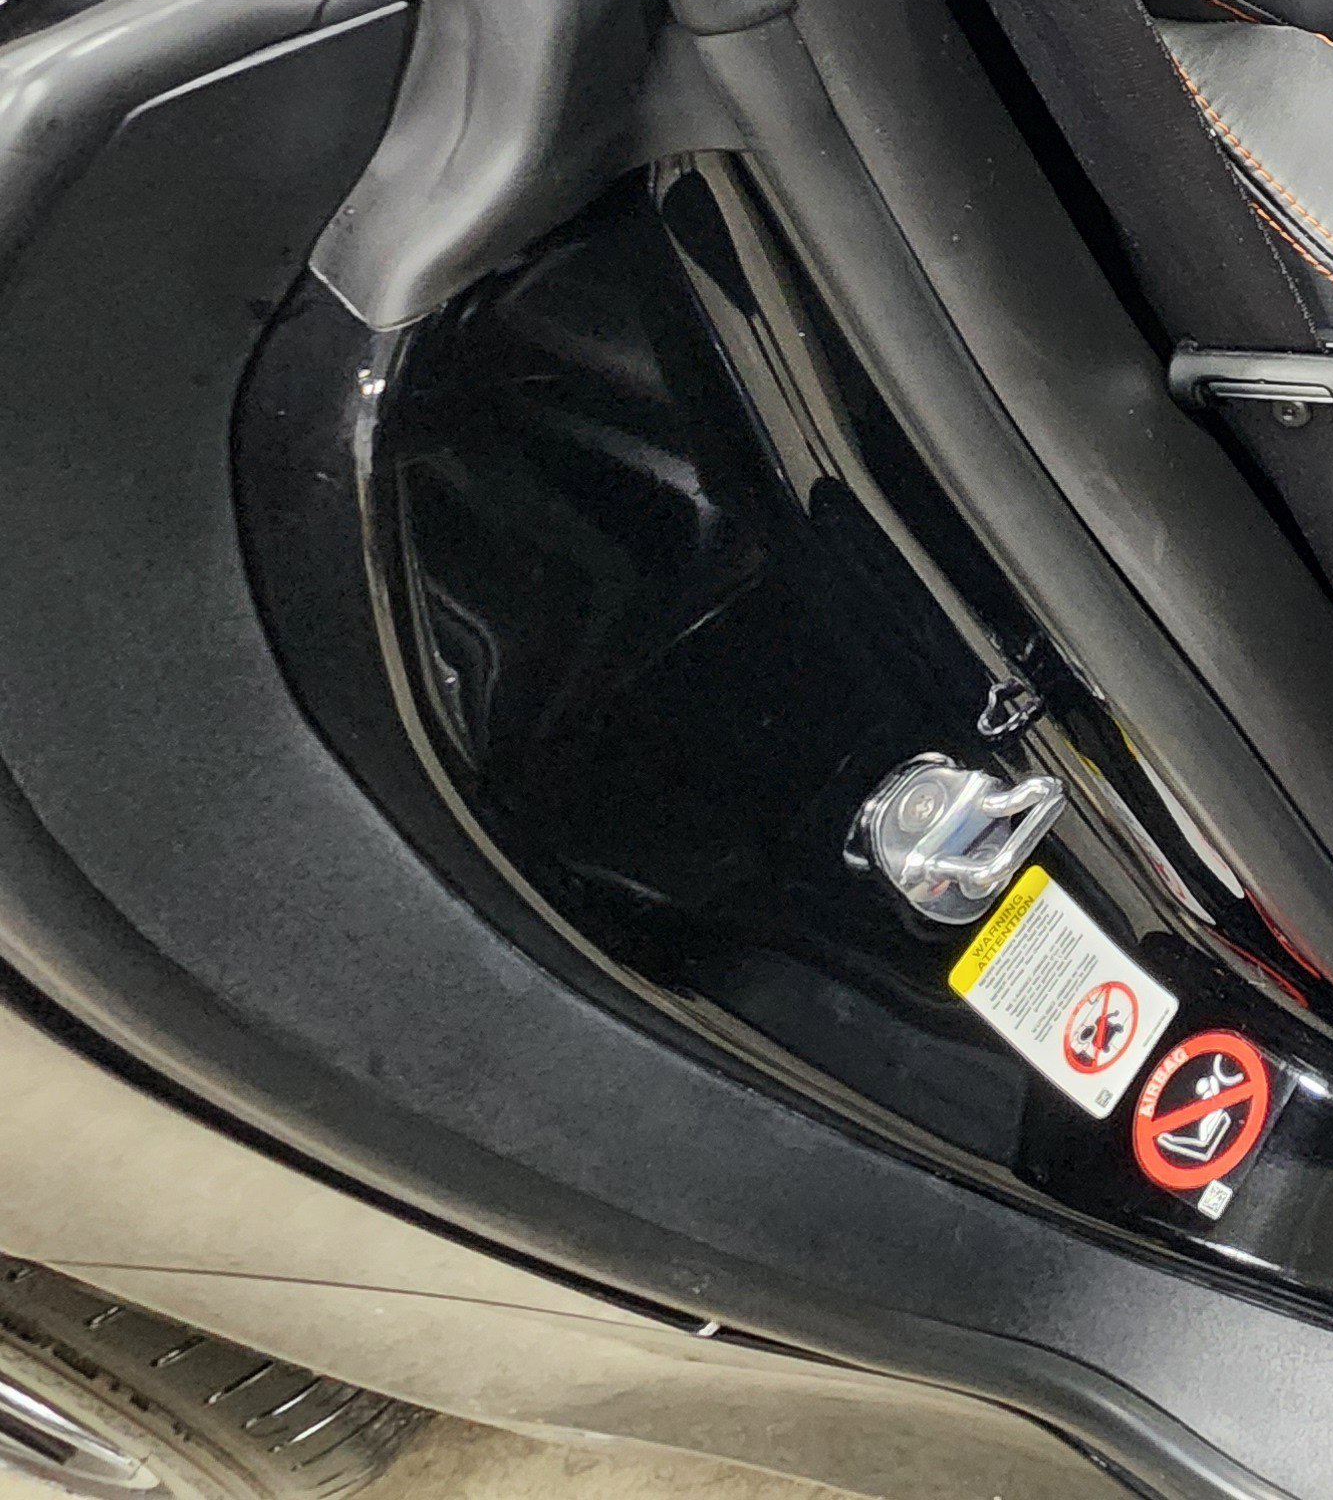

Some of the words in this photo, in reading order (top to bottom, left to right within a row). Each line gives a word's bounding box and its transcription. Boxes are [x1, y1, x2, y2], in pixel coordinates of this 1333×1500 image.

[972, 893, 1025, 958] WARNING
[978, 894, 1035, 973] ATTENTION
[1139, 1047, 1190, 1118] AIRBAG
